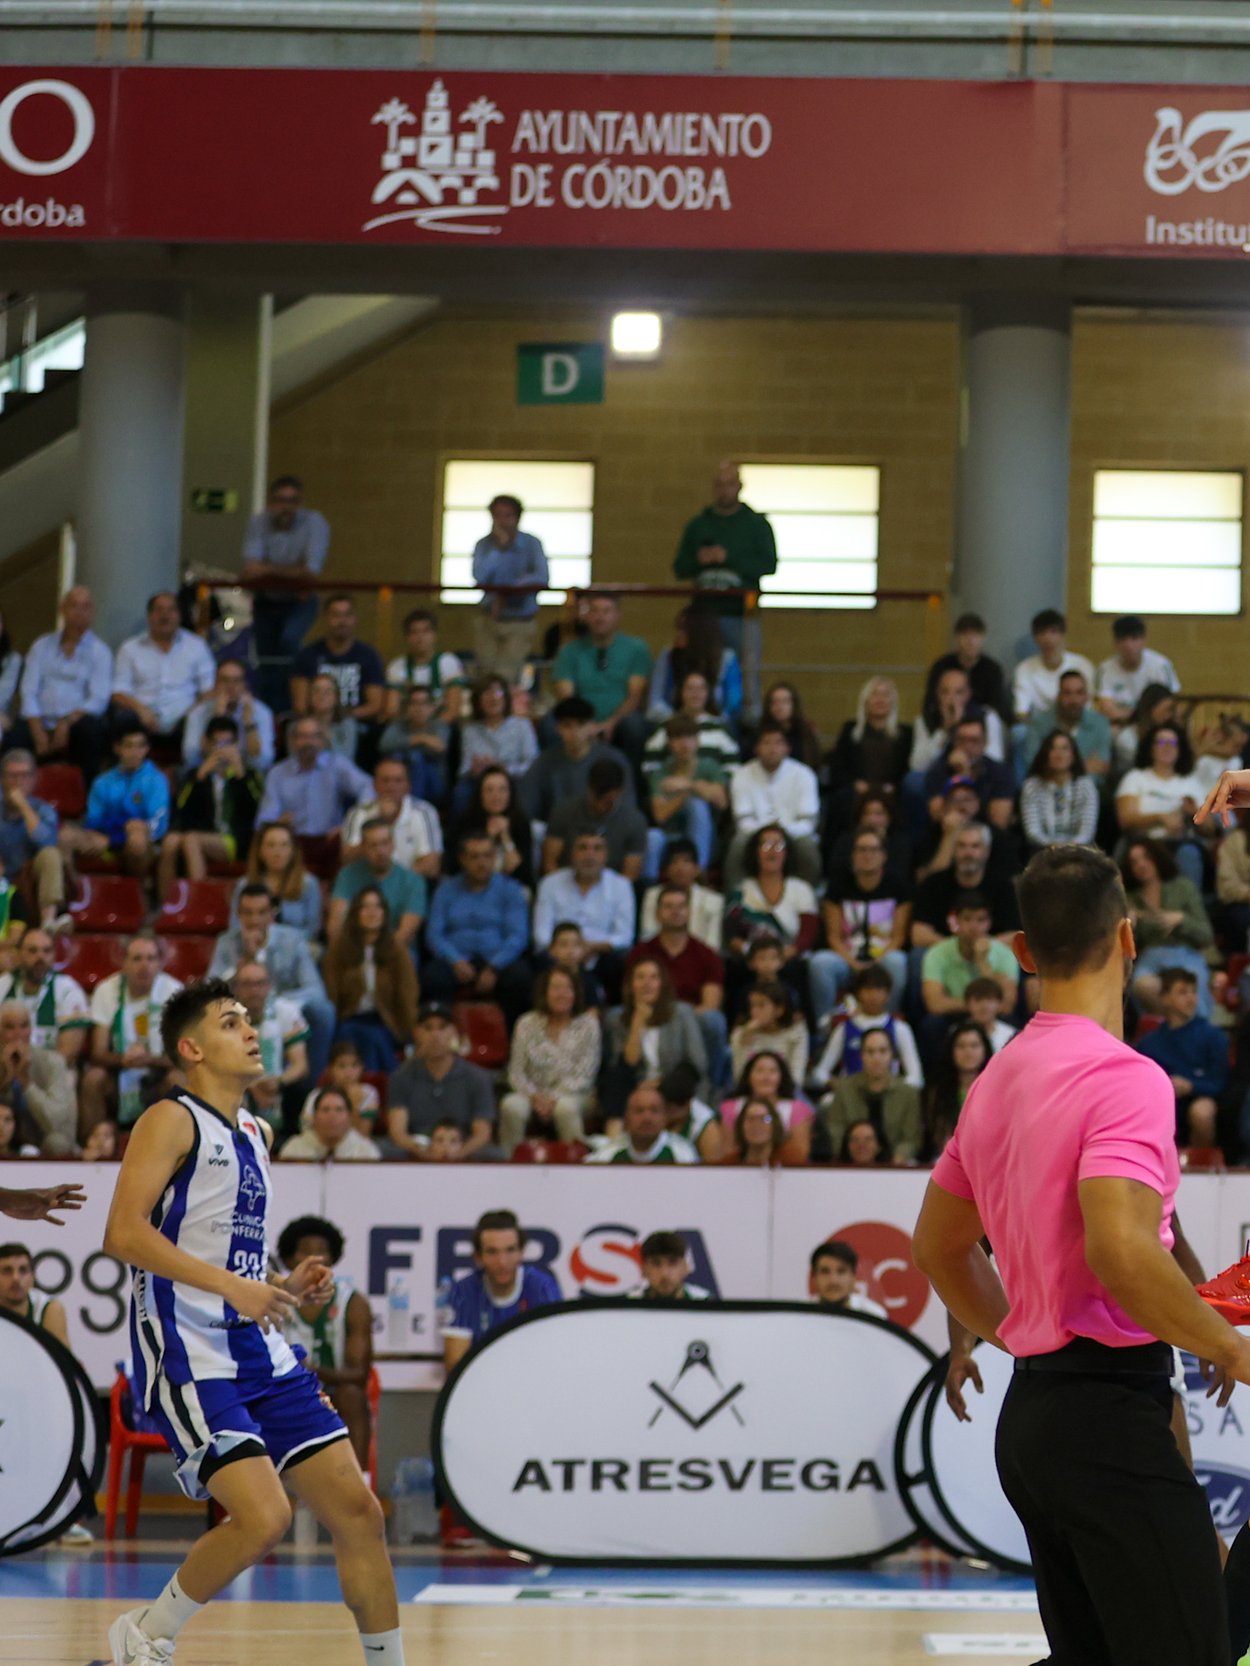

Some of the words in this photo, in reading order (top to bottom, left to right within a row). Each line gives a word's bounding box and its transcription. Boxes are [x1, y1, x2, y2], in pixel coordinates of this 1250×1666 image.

[511, 109, 772, 158] AYUNTAMIENTO
[510, 163, 555, 208] DE
[561, 158, 731, 210] CÓRDOBA
[541, 353, 580, 395] D
[511, 1458, 887, 1492] ATRESVEGA
